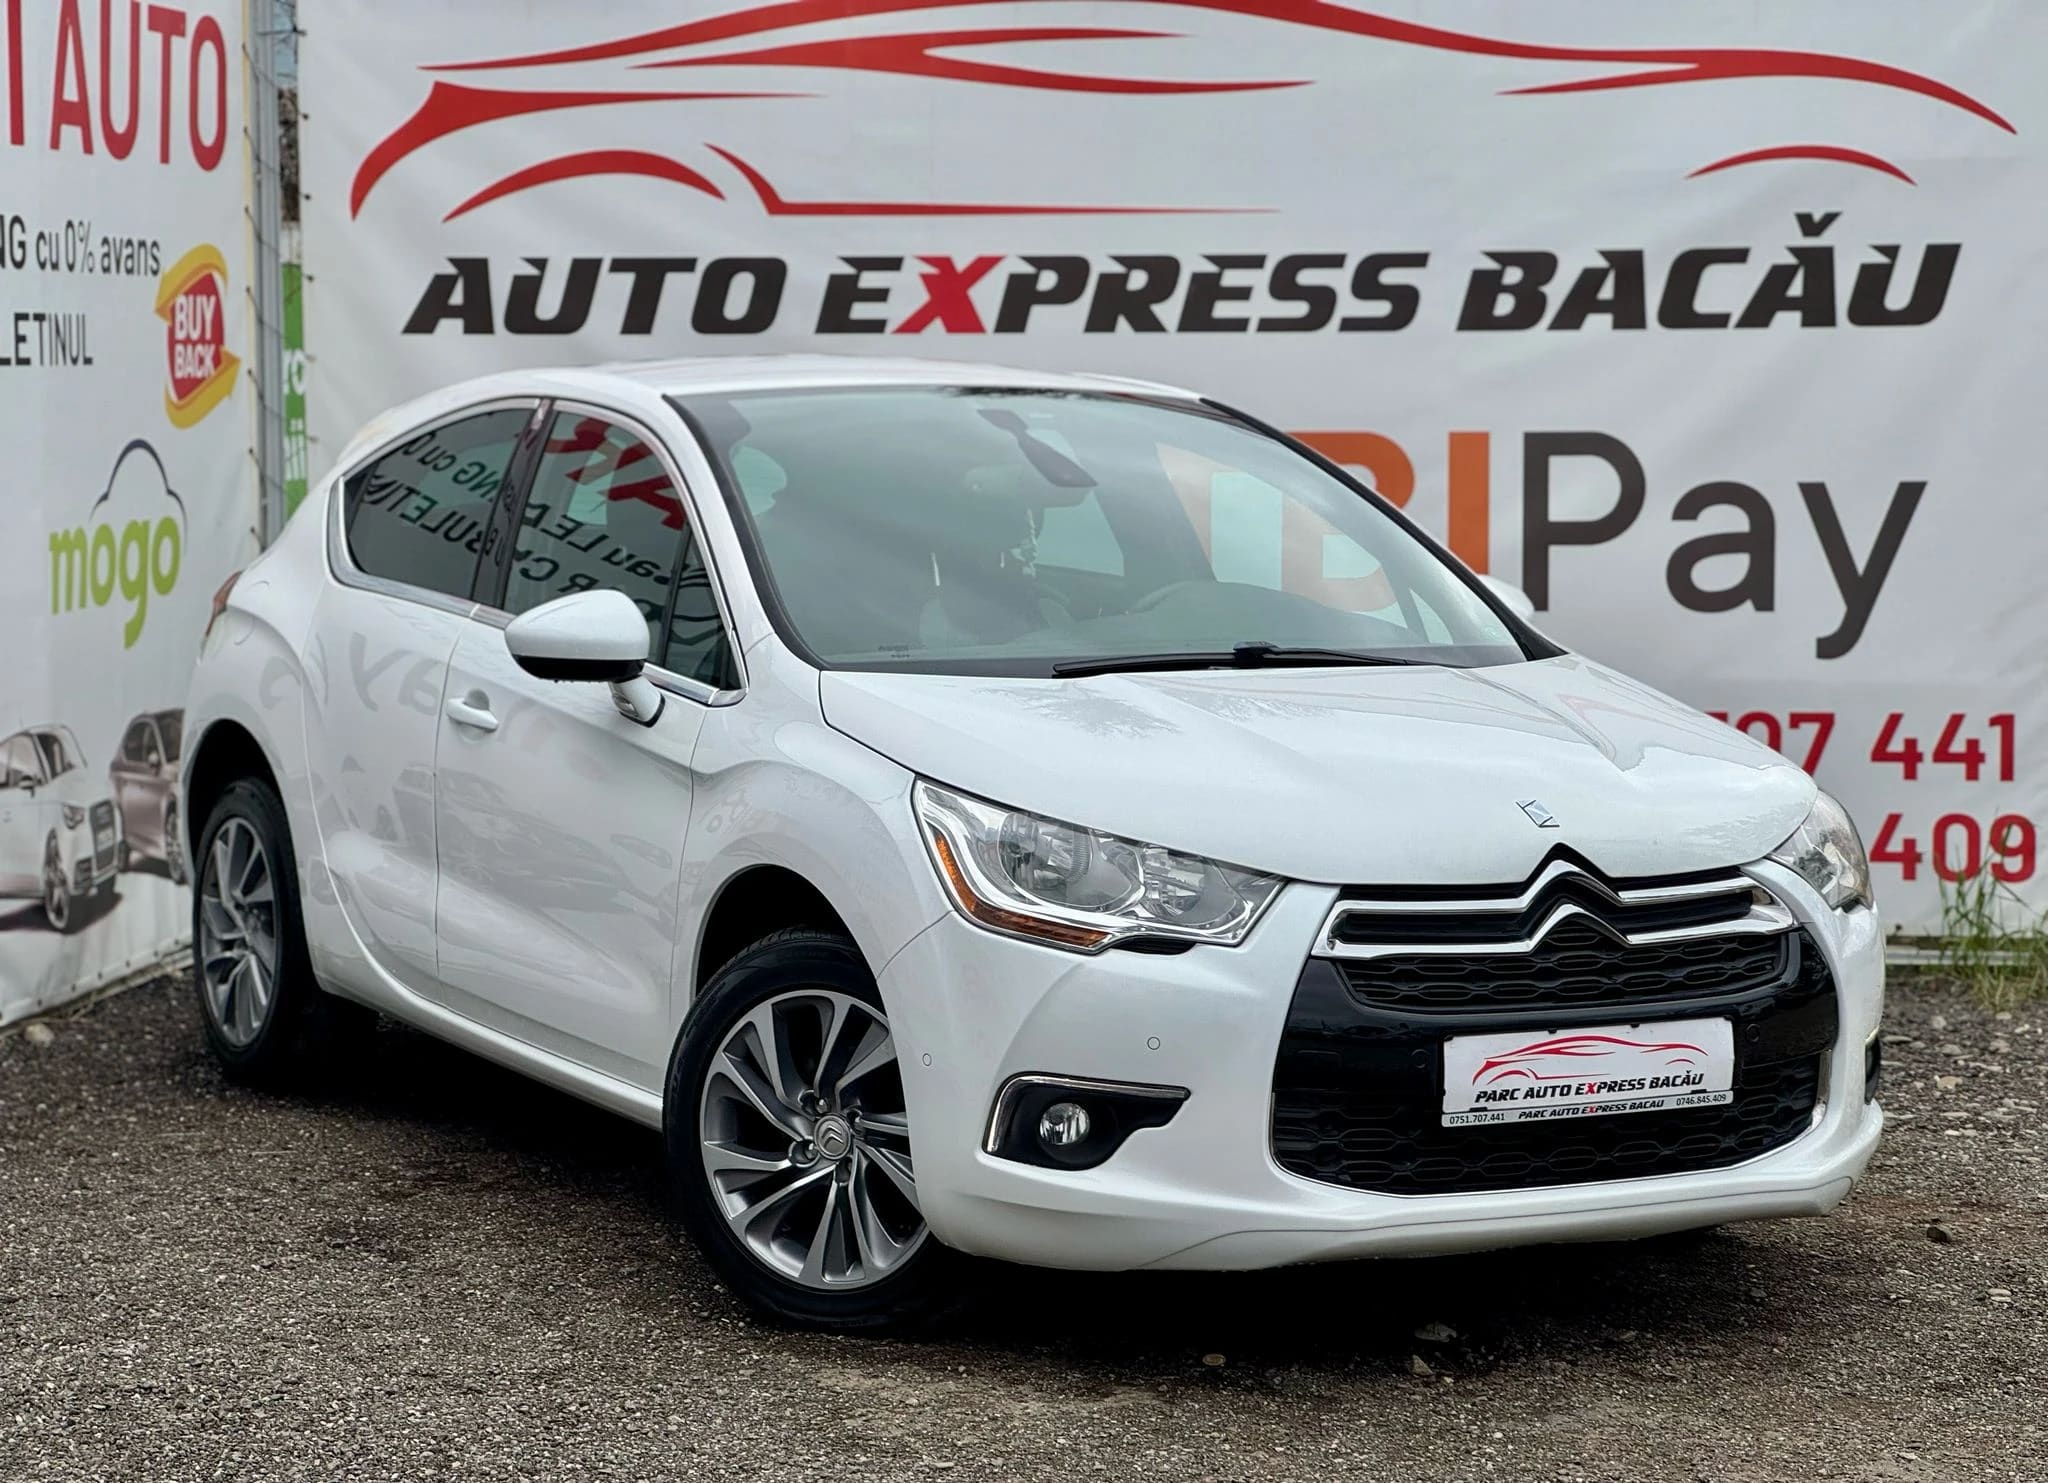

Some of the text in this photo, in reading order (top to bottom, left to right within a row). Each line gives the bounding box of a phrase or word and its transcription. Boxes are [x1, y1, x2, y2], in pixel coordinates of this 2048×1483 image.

[50, 0, 227, 171] AUTO
[36, 230, 59, 271] cu
[65, 219, 95, 274] 0%
[100, 235, 160, 277] avans
[402, 211, 1963, 334] AUTO EXPRESS BACĂU
[174, 293, 217, 341] BUY
[174, 343, 216, 379] BACK
[49, 516, 181, 650] mogo
[1871, 712, 2015, 782] 441
[1869, 813, 2037, 883] 409
[1475, 1070, 1704, 1103] PARC AUTO EXPRESS BACĂU
[1518, 1109, 1548, 1120] PARC
[1550, 1107, 1580, 1117] AUTO
[1581, 1103, 1628, 1115] EXPRESS
[1676, 1094, 1727, 1106] 0746.845.409
[1449, 1113, 1505, 1125] 0751.707.441
